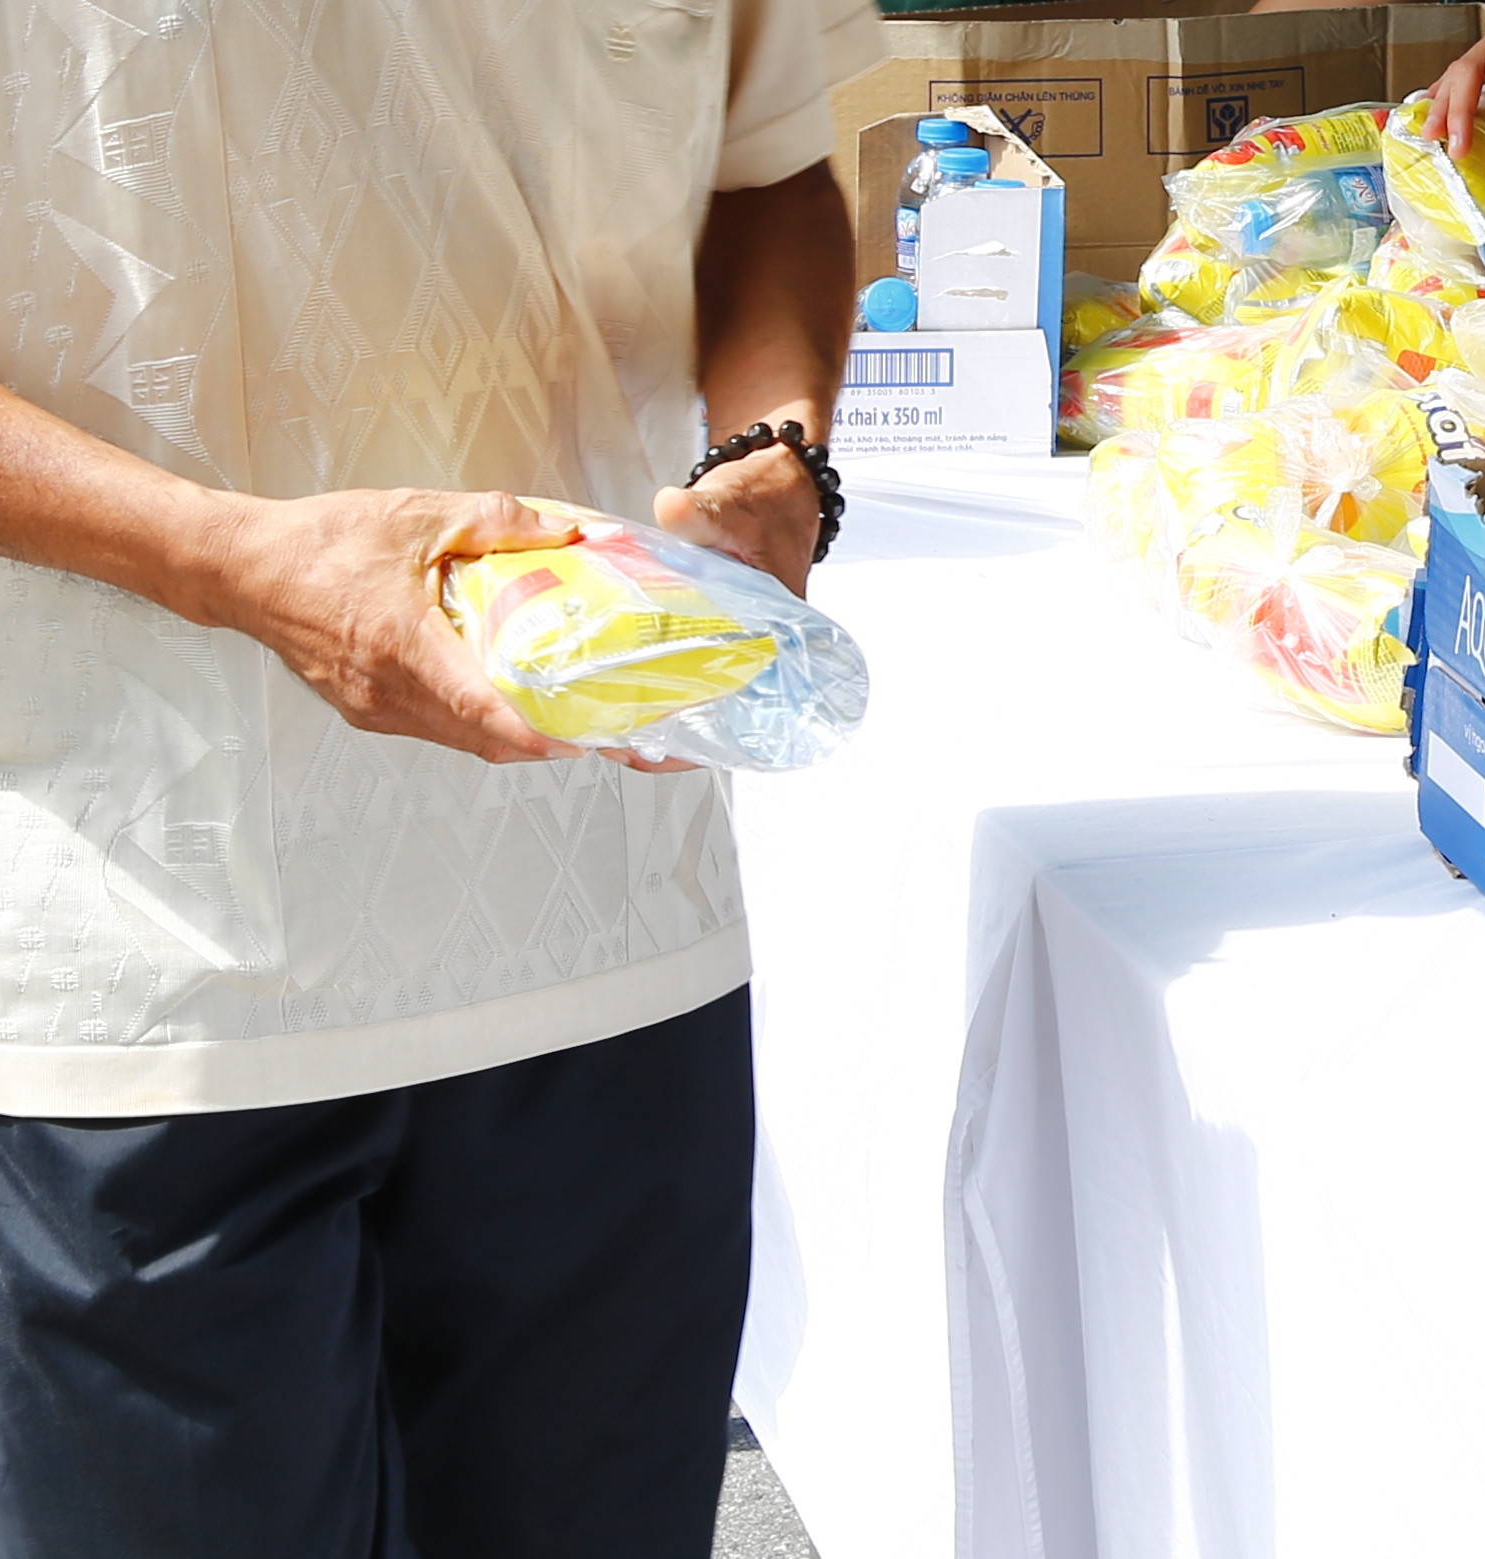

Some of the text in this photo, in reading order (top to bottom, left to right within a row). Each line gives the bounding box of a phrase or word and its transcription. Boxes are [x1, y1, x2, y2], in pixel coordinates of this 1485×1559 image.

[937, 92, 974, 103] KHÔNG
[831, 406, 943, 427] 4 chai x 350 ml
